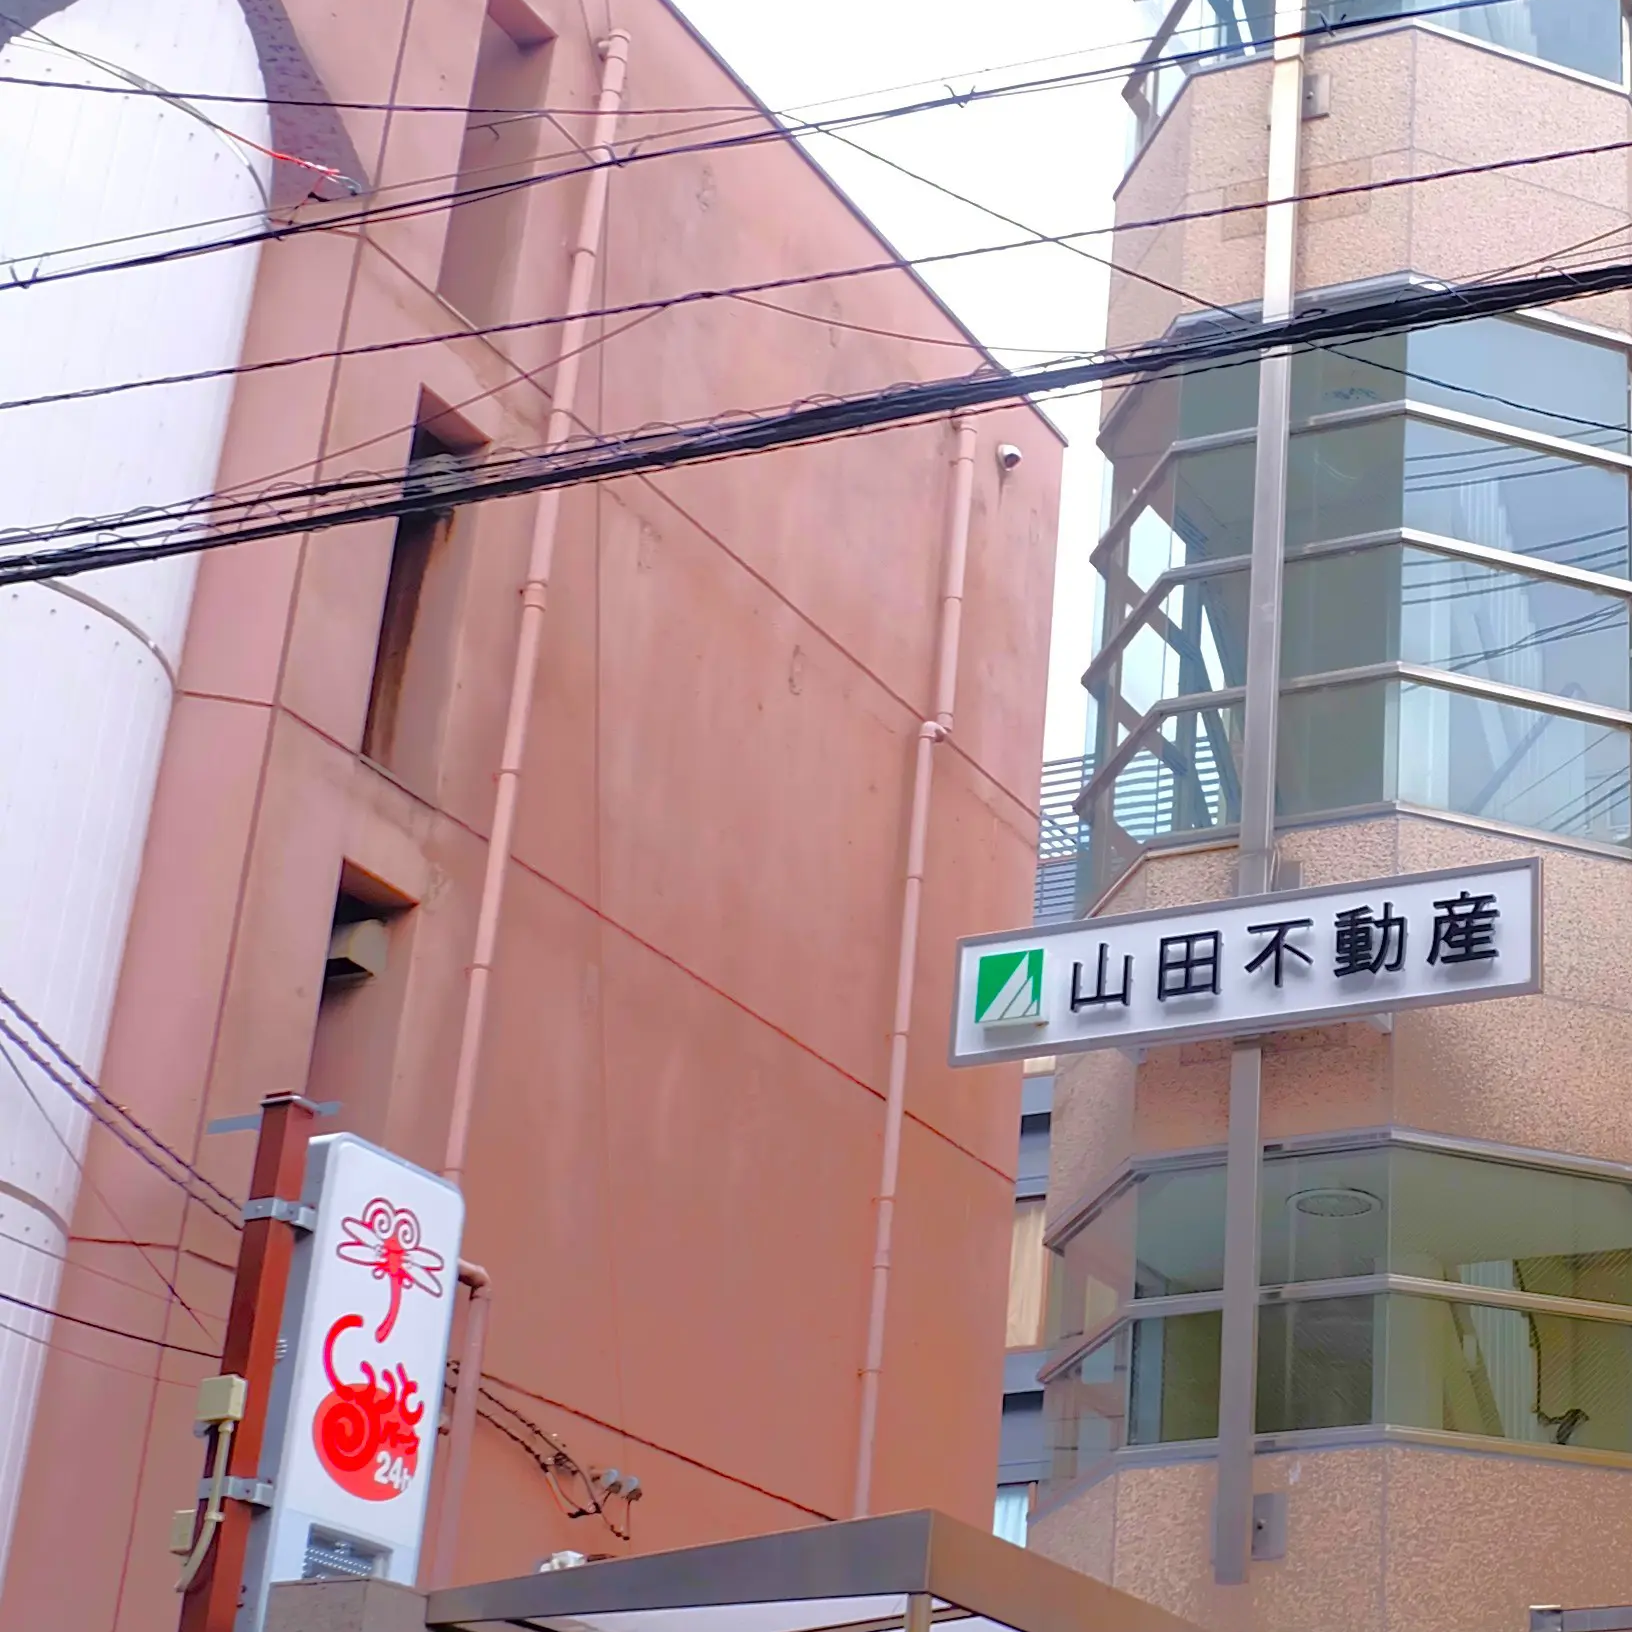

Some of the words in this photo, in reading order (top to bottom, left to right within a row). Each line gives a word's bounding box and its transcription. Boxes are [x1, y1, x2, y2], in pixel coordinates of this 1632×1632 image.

[1069, 890, 1501, 1014] 山田不動産
